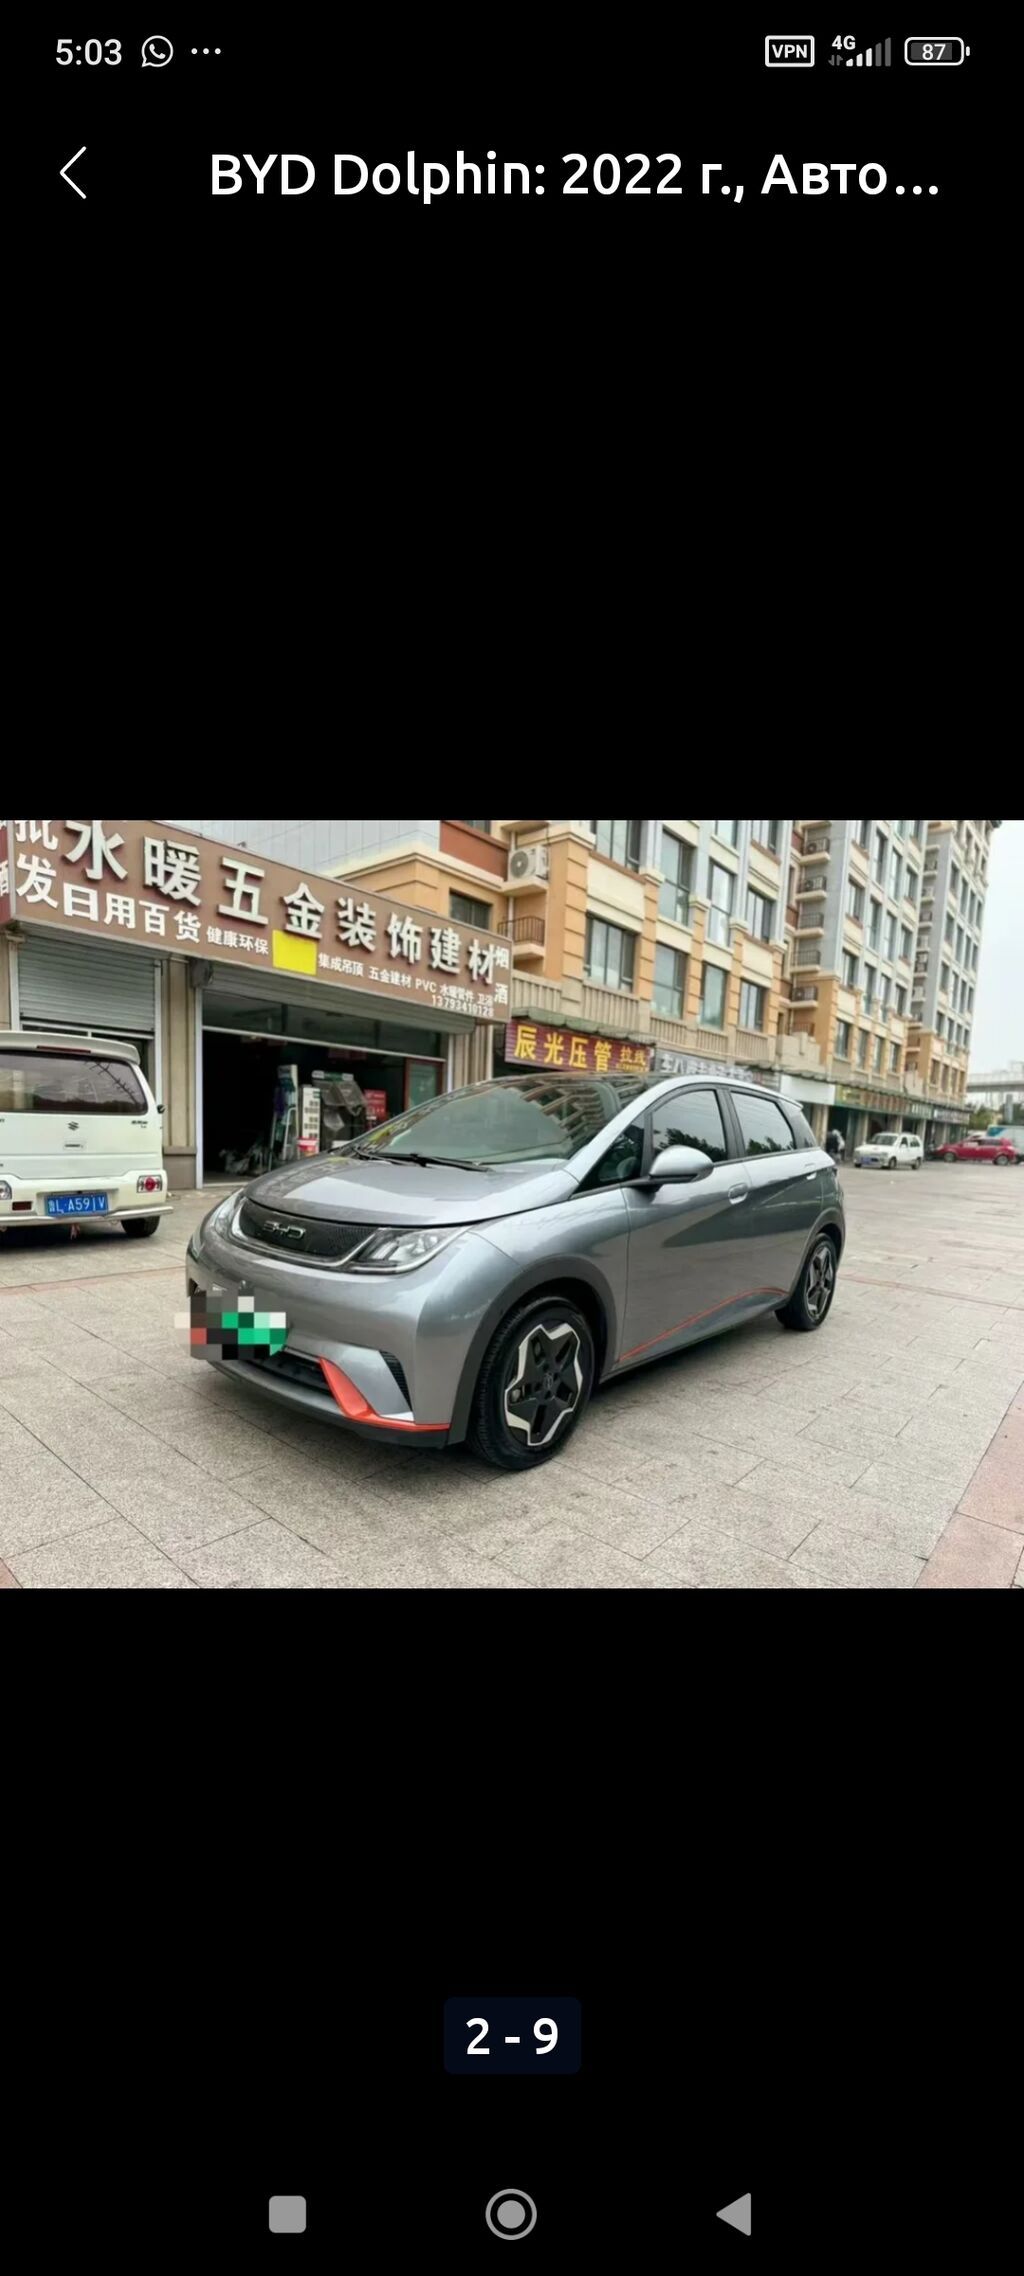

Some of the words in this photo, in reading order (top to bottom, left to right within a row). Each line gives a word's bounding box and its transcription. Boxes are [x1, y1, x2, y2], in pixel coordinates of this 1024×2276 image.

[64, 820, 498, 986] 水暖五金装饰建材
[205, 925, 270, 956] 健康环保
[318, 952, 364, 978] 集成吊顶
[368, 965, 413, 989] 五金建材
[415, 977, 438, 994] PVC
[513, 1024, 613, 1072] 辰光压管
[262, 1220, 306, 1239] BYD
